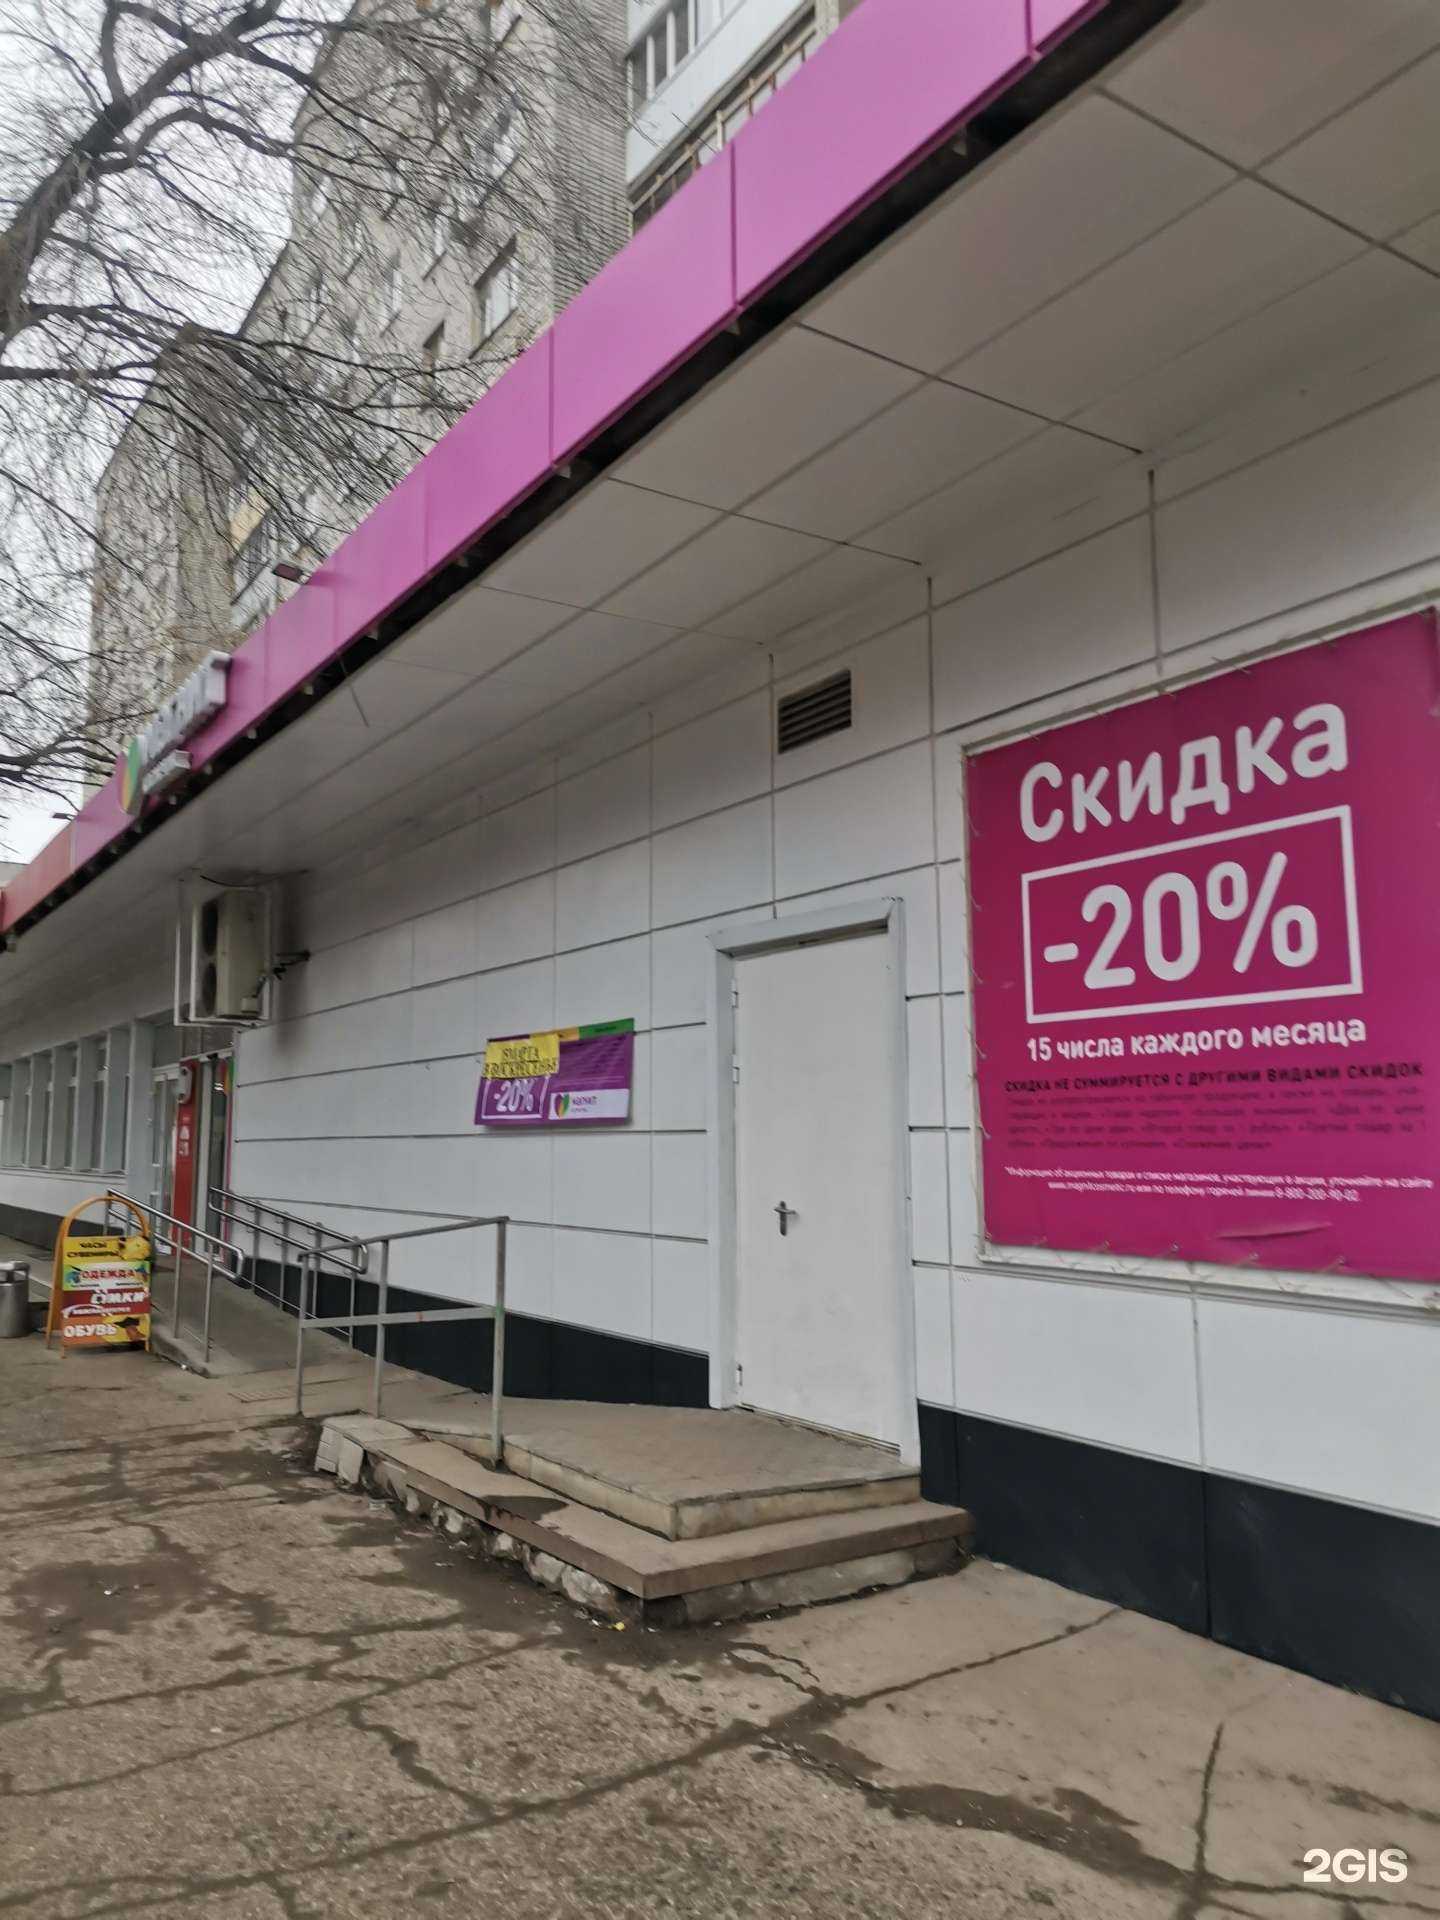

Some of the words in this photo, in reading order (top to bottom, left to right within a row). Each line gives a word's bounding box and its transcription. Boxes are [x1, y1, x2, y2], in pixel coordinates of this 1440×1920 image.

[1019, 702, 1349, 843] Скидка
[1043, 851, 1319, 990] -20%
[1027, 1036, 1051, 1062] 15
[1056, 1033, 1126, 1060] числа
[1130, 1024, 1242, 1057] каждого
[1251, 1017, 1367, 1049] месяца
[1005, 1079, 1051, 1092] СКИДКА
[1054, 1078, 1069, 1090] НЕ
[1074, 1073, 1170, 1090] СУММИРУЕТСЯ
[1175, 1073, 1184, 1086] С
[1188, 1068, 1261, 1087] ДРУГИМИ
[1267, 1065, 1340, 1083] ВИДАМИ
[1347, 1062, 1424, 1079] СКИДОК
[82, 1269, 135, 1280] ОДЕЖДА
[64, 1324, 117, 1338] ОБУВЬ
